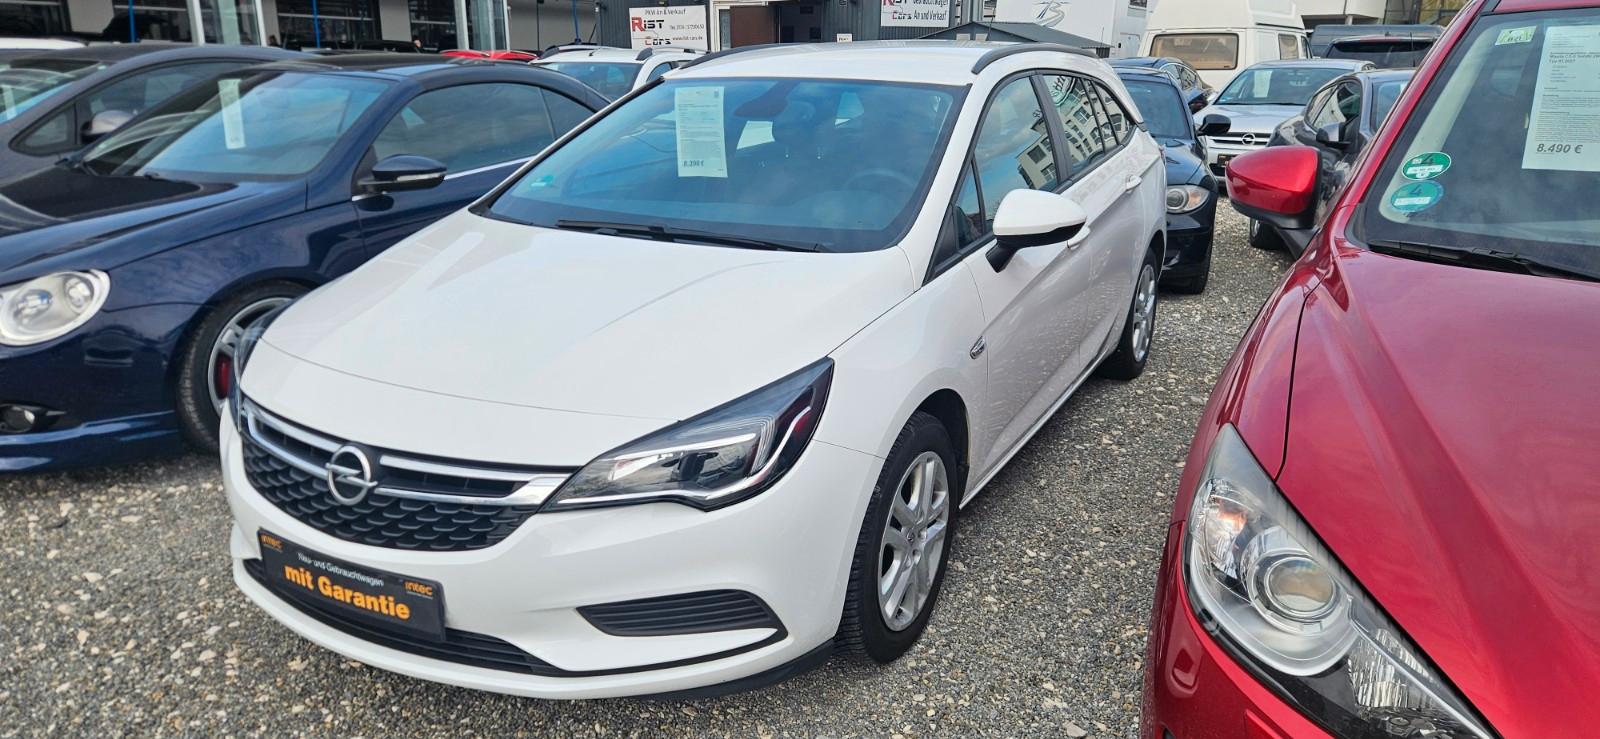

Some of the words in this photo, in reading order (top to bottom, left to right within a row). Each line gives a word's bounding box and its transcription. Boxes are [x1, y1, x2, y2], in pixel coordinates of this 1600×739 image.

[892, 11, 912, 20] Cars
[913, 10, 921, 20] An
[921, 10, 930, 20] und
[930, 10, 948, 20] Verkauf
[645, 36, 671, 46] Cars
[1536, 143, 1571, 154] 8.490
[1574, 144, 1583, 154] €
[1421, 153, 1434, 165] 4
[1409, 183, 1422, 196] 4
[314, 560, 326, 570] und
[326, 563, 384, 587] Gebrauchtwagen
[284, 565, 314, 590] mit
[317, 575, 410, 620] Garantie
[404, 581, 433, 596] intec
